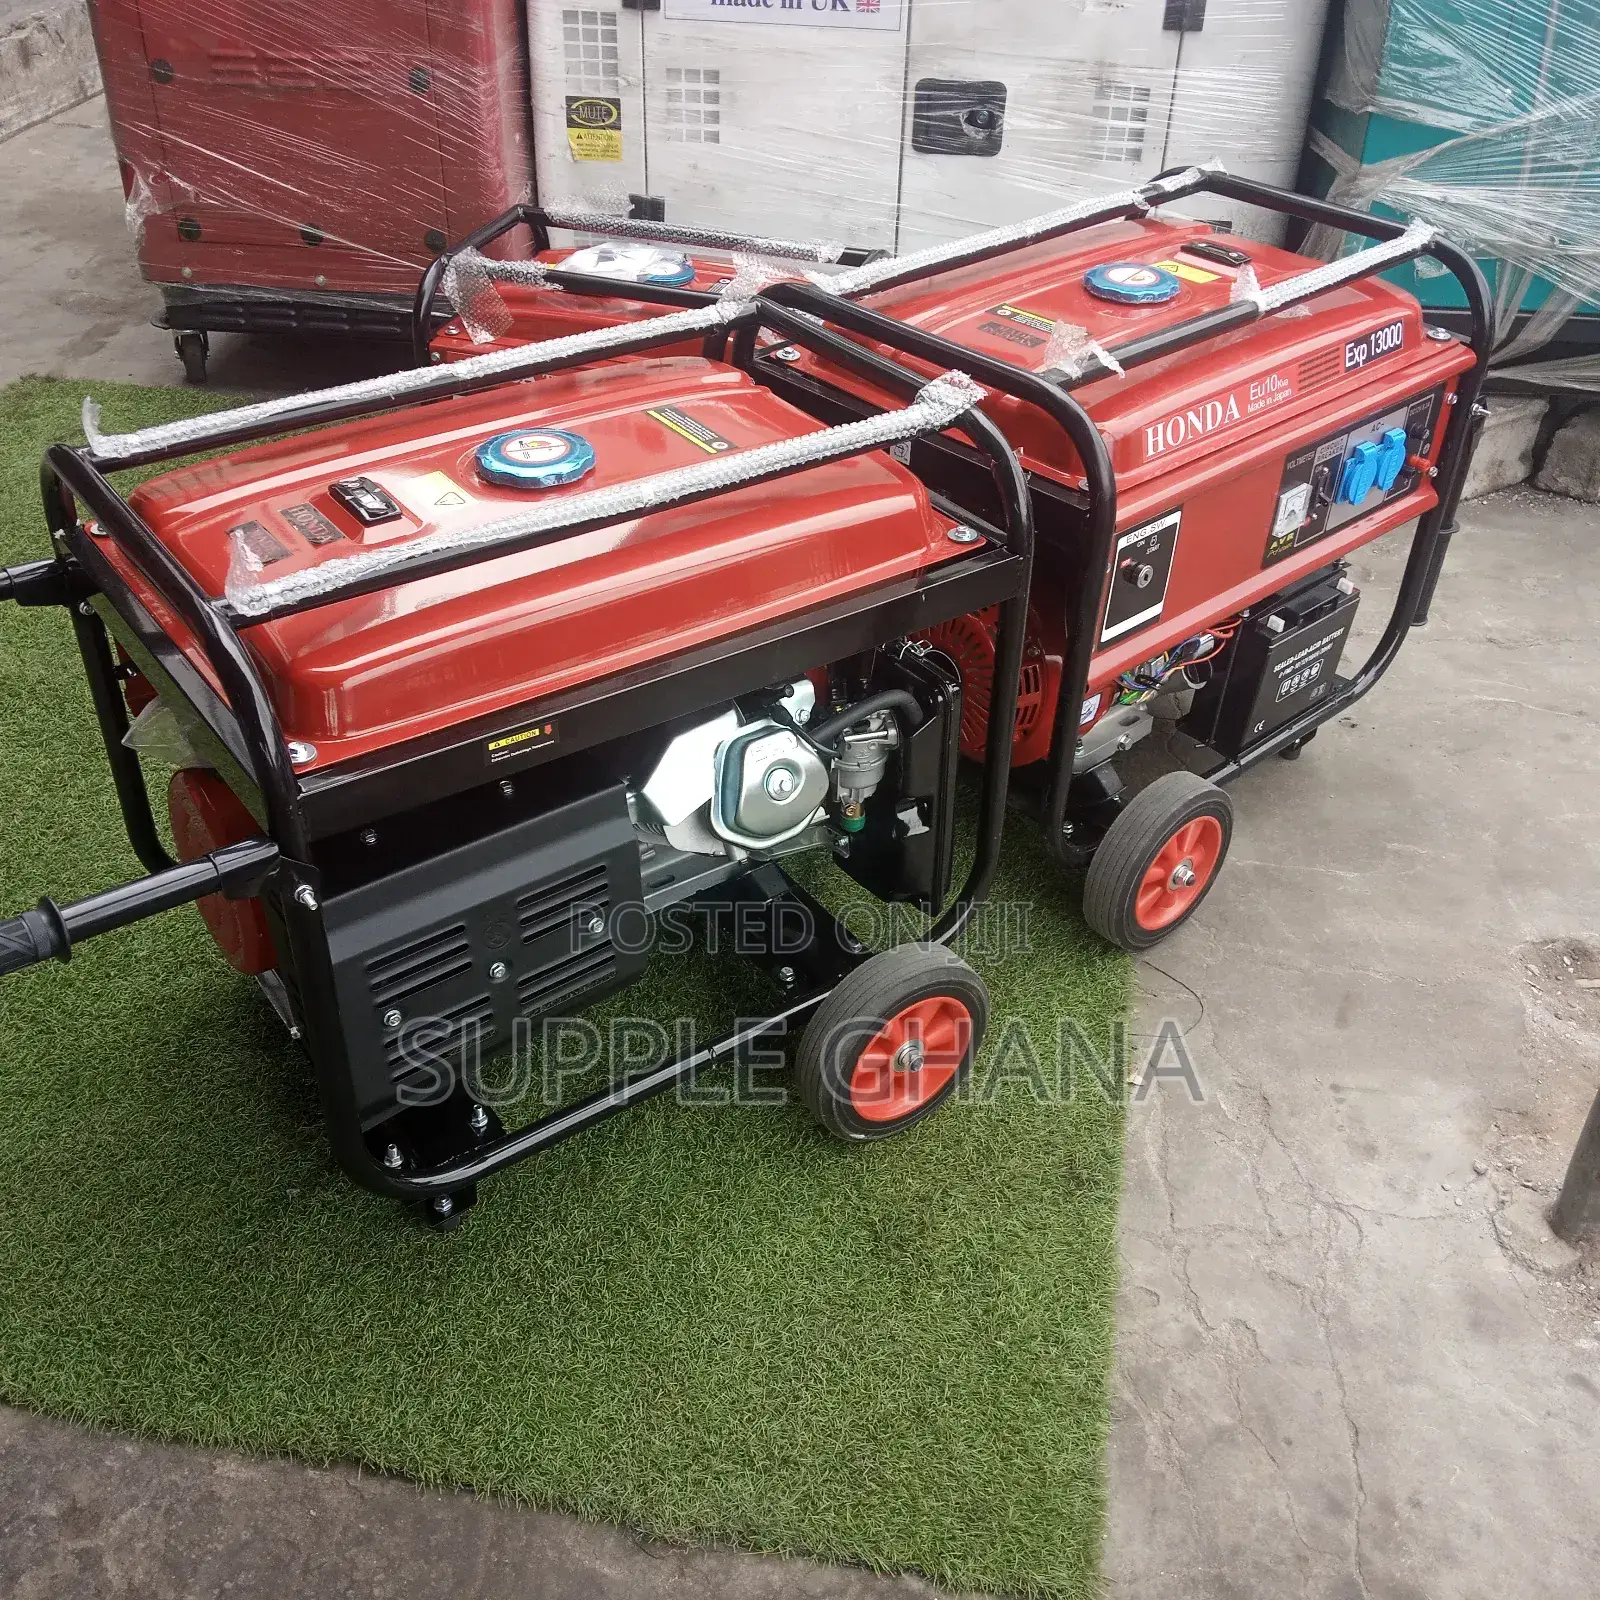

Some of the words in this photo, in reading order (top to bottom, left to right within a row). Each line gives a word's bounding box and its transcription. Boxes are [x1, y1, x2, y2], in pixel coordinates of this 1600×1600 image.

[579, 105, 609, 120] MUTE
[1345, 342, 1368, 368] Exp
[1370, 322, 1402, 356] 13000
[1247, 399, 1266, 413] Made
[1273, 388, 1292, 403] Japan
[1145, 394, 1241, 457] HONDA
[287, 505, 333, 543] HONDA
[1269, 532, 1294, 550] AVR
[505, 730, 538, 745] CAUTION
